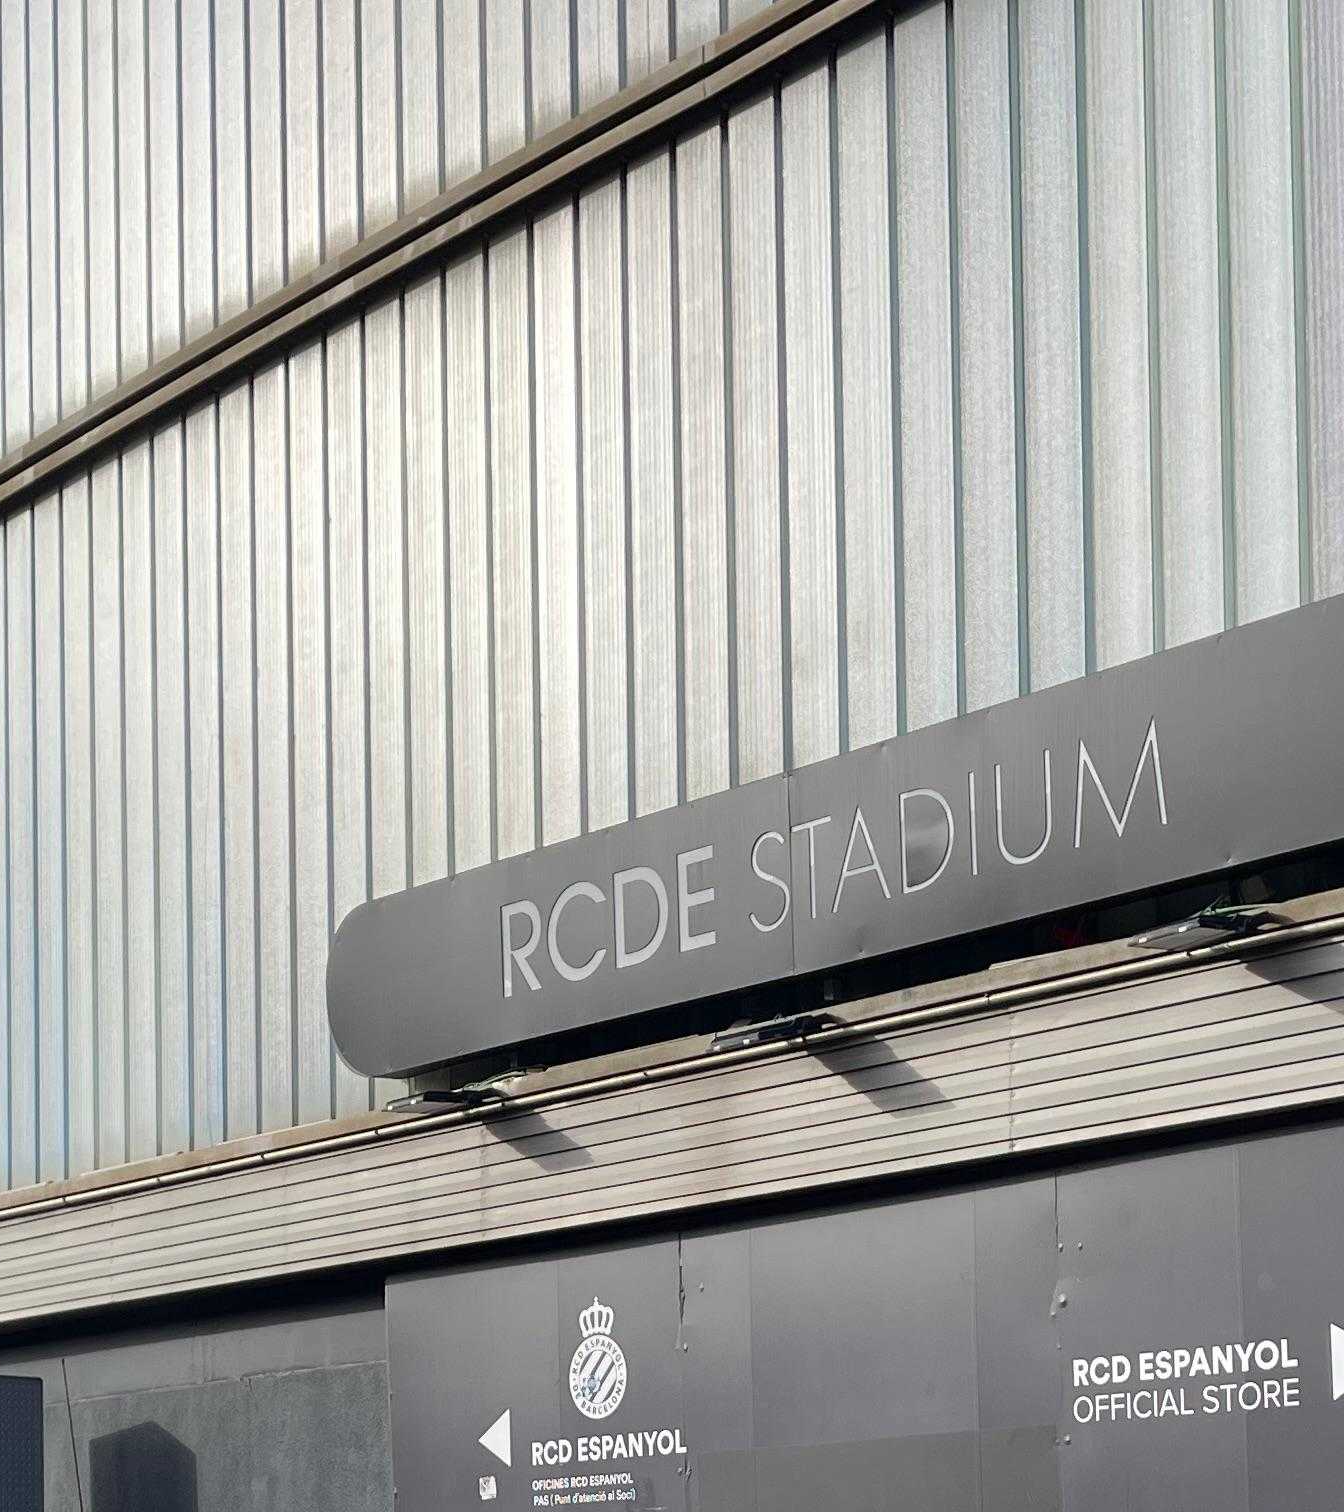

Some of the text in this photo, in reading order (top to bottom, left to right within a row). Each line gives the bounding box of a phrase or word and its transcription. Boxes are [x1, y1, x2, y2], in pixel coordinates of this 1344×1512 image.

[501, 716, 1168, 998] RCDE STADIUM
[1072, 1338, 1299, 1387] RCD ESPANYOL
[1073, 1377, 1300, 1424] OFFICIAL STORE
[531, 1429, 687, 1466] RCD ESPANYOL
[532, 1473, 634, 1492] OFICINES RCD ESPANYOL
[533, 1495, 549, 1506] PAS
